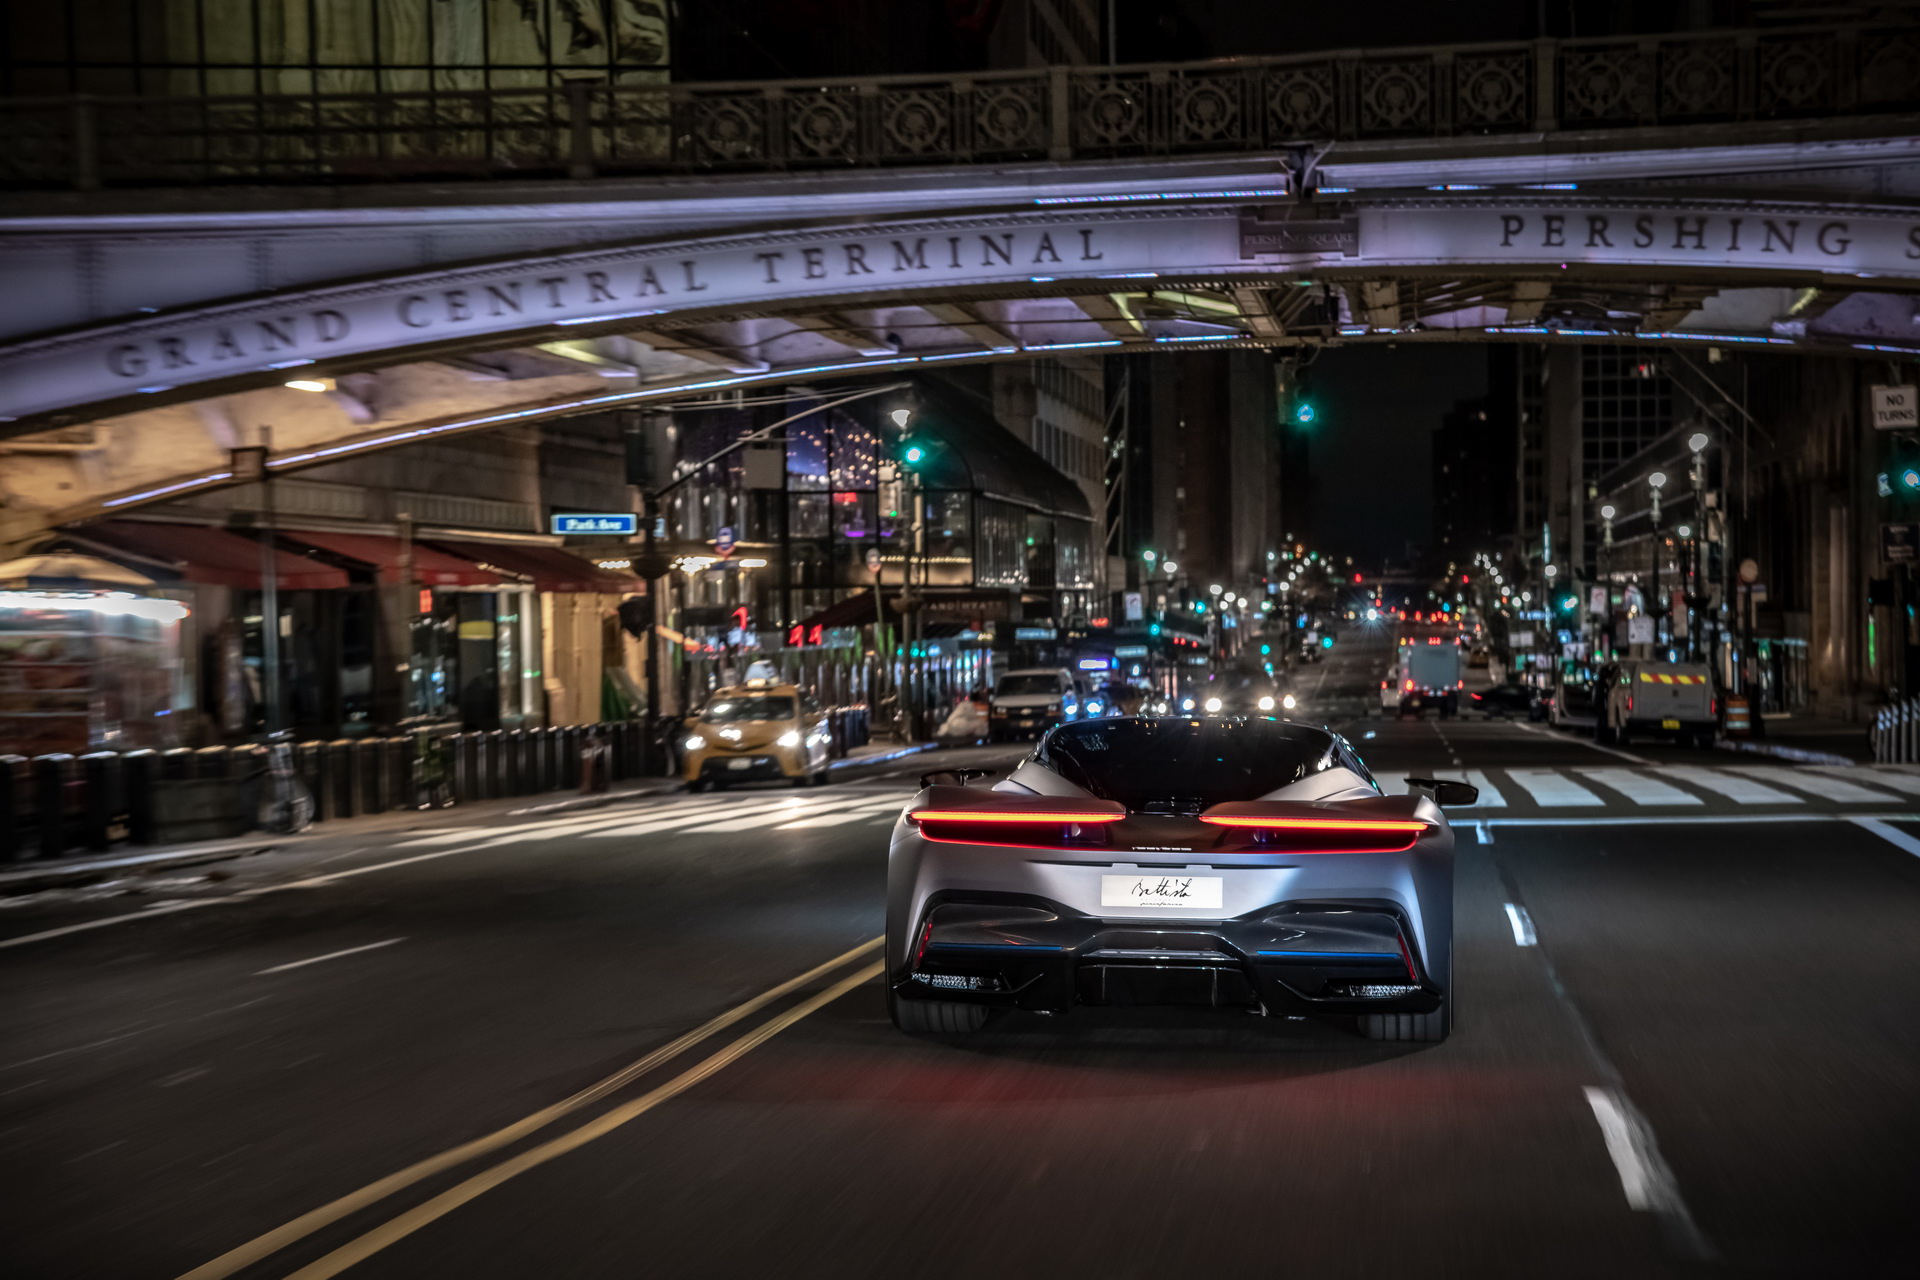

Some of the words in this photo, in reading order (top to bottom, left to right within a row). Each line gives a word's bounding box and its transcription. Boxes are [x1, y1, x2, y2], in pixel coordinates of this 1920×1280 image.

[1307, 231, 1354, 245] SQUARE
[1500, 214, 1853, 256] PERSHING
[107, 309, 351, 377] GRAND
[397, 260, 707, 328] CENTRAL
[754, 229, 1103, 283] TERMINAL
[1886, 394, 1905, 406] NO
[1878, 410, 1915, 421] TURNS
[566, 519, 596, 531] Park
[1131, 876, 1193, 898] Battista
